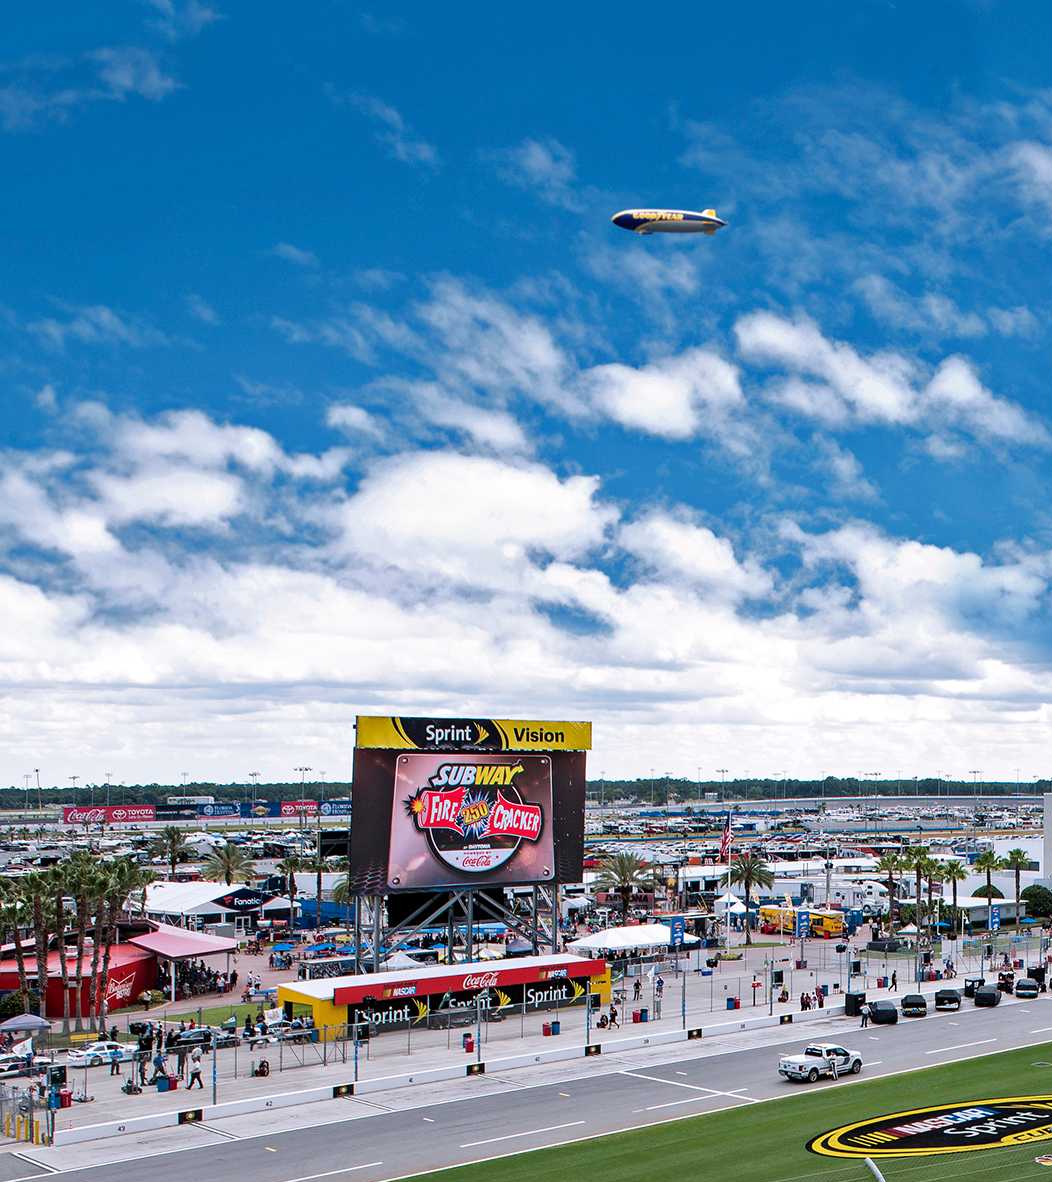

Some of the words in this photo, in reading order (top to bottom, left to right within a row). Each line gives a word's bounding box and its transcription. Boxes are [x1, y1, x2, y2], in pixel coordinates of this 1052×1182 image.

[426, 724, 472, 745] Sprint
[513, 727, 565, 743] Vision
[432, 764, 525, 786] SUBWAY
[127, 808, 154, 816] TOYOTA
[430, 795, 459, 824] FIRE
[462, 801, 490, 825] 250
[493, 804, 540, 832] CRACKER
[392, 986, 417, 997] NASCAR
[527, 984, 568, 1008] Sprint
[361, 1004, 411, 1025] Sprint
[893, 1107, 995, 1135] NASCAR
[943, 1111, 1050, 1138] Sprint
